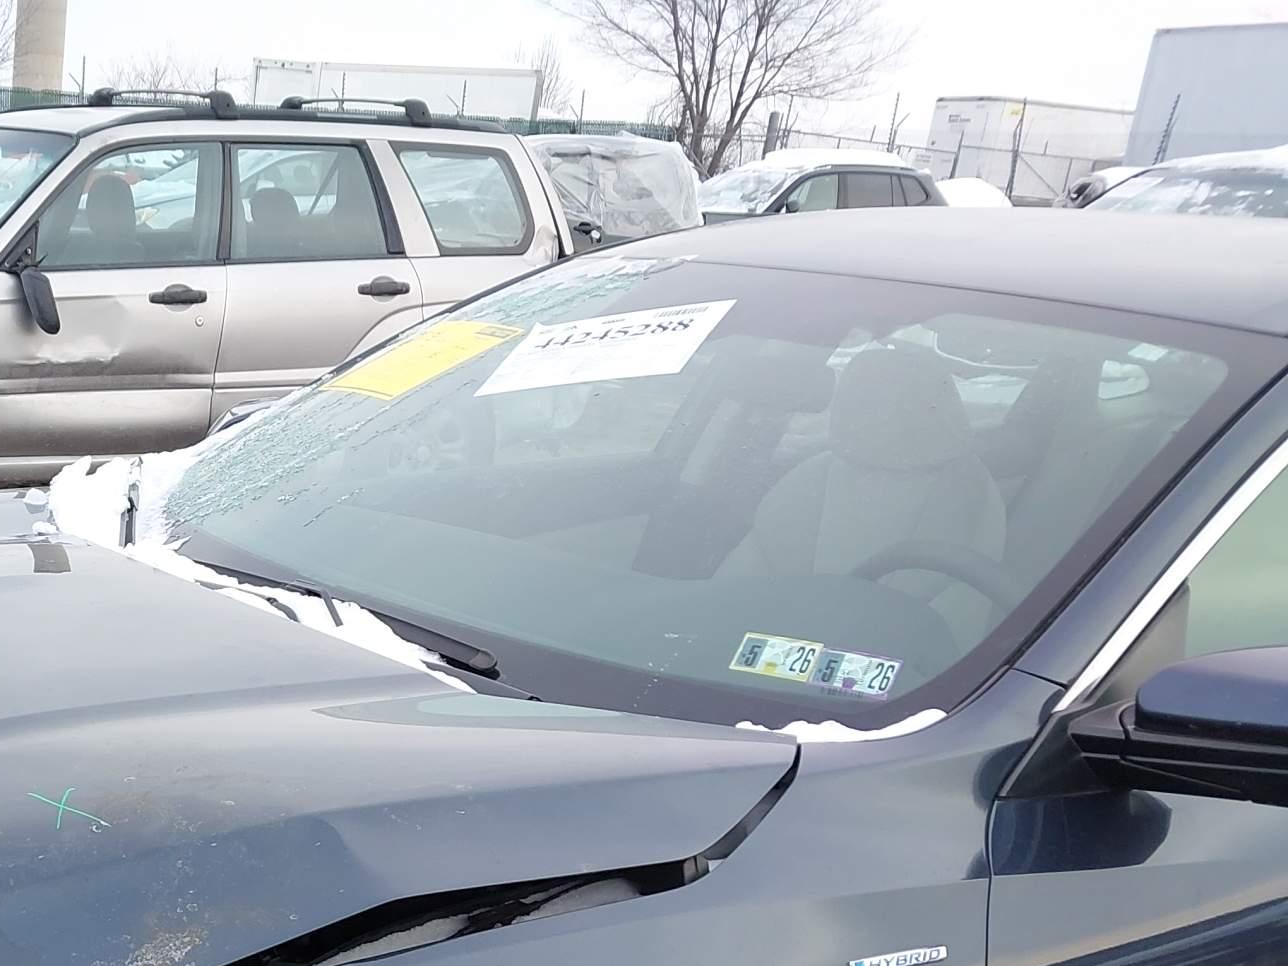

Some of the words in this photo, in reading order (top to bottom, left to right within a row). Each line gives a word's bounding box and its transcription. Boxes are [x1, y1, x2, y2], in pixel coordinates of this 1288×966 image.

[533, 317, 696, 350] 44245288
[744, 644, 761, 667] 5
[789, 646, 816, 674] 26
[820, 659, 839, 683] 5
[868, 662, 895, 691] 26
